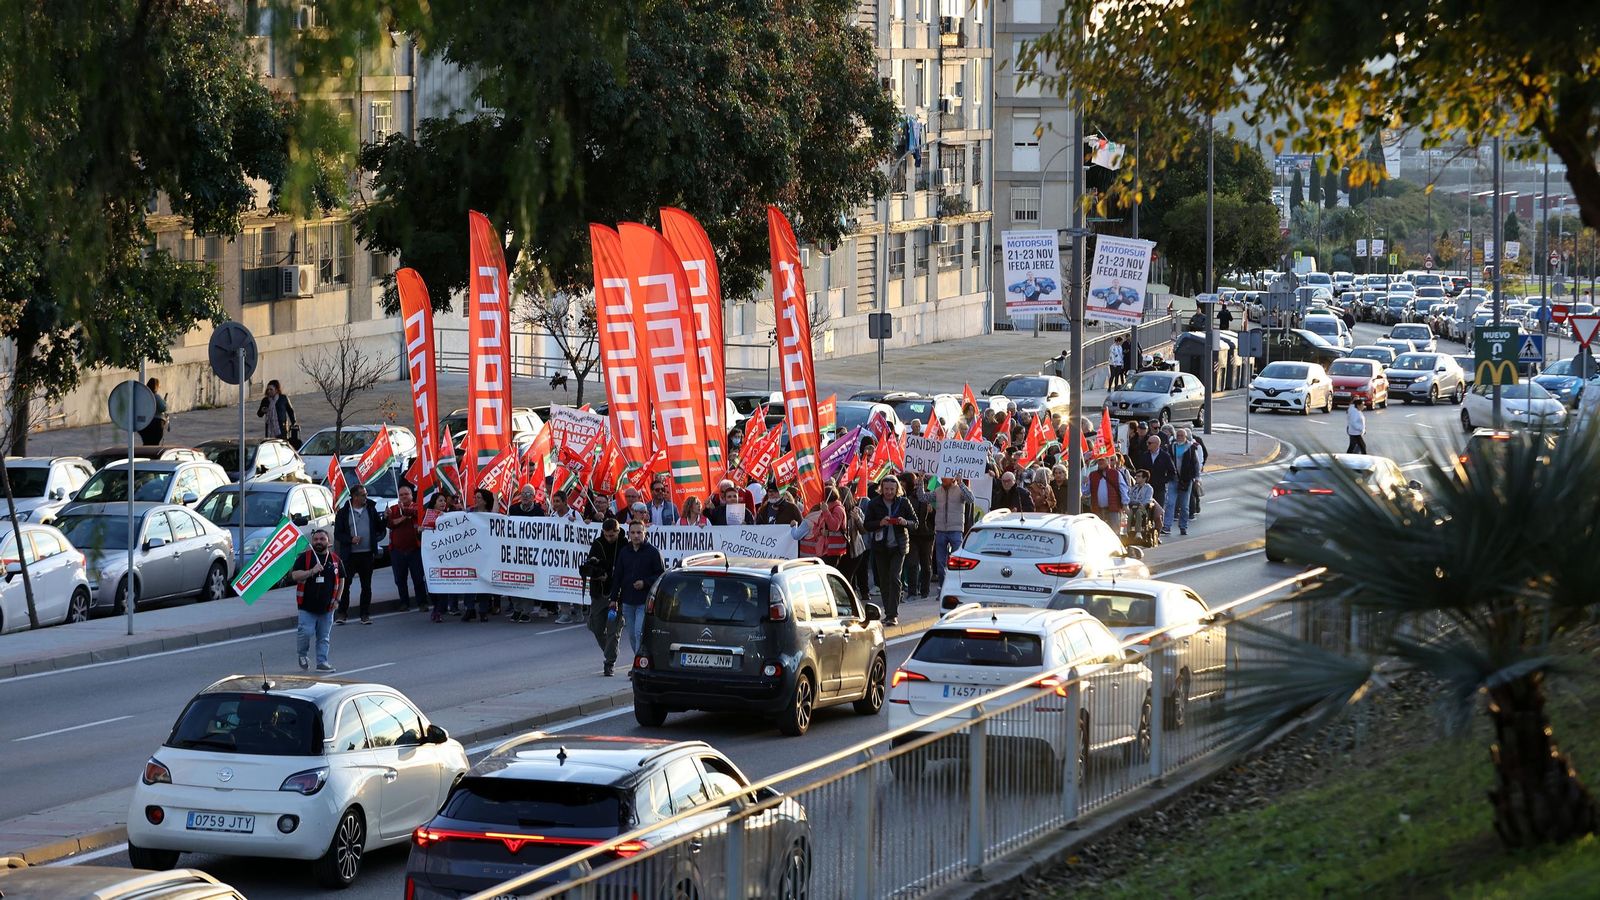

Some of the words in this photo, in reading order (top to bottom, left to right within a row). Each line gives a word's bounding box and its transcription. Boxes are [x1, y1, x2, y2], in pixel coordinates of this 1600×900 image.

[1007, 240, 1053, 248] MOTORSUR
[1008, 250, 1034, 260] 21-23
[1036, 249, 1054, 259] NOV
[1100, 245, 1146, 257] MOTORSUR
[1008, 261, 1031, 271] IFECA
[1032, 260, 1055, 270] JEREZ
[1098, 254, 1125, 268] 21-23
[1126, 257, 1145, 270] NOV
[1096, 266, 1118, 277] IFECA
[1119, 269, 1143, 281] JEREZ
[1483, 331, 1510, 339] NUEVO
[553, 419, 596, 437] MAREA
[906, 436, 941, 453] SANIDAD
[977, 444, 989, 452] CON
[943, 454, 952, 463] LA
[954, 455, 984, 465] SANIDAD
[456, 514, 470, 526] LA
[430, 528, 478, 550] SANIDAD
[489, 518, 505, 537] POR
[507, 521, 517, 539] EL
[519, 521, 562, 542] HOSPITAL
[564, 523, 574, 543] DE
[576, 527, 598, 546] JEREZ
[669, 531, 714, 550] PRIMARIA
[740, 530, 758, 543] POR
[761, 536, 777, 548] LOS
[993, 532, 1055, 544] PLAGATEX
[438, 542, 482, 563] PÚBLICA
[501, 545, 511, 563] DE
[513, 546, 538, 566] JEREZ
[541, 548, 570, 568] COSTA
[441, 569, 469, 577] CCOO
[502, 572, 526, 581] CCOO
[687, 655, 710, 664] 3444
[714, 657, 731, 666] JNW
[952, 687, 976, 697] 1457
[195, 815, 225, 827] 0759
[229, 817, 252, 829] JTY
